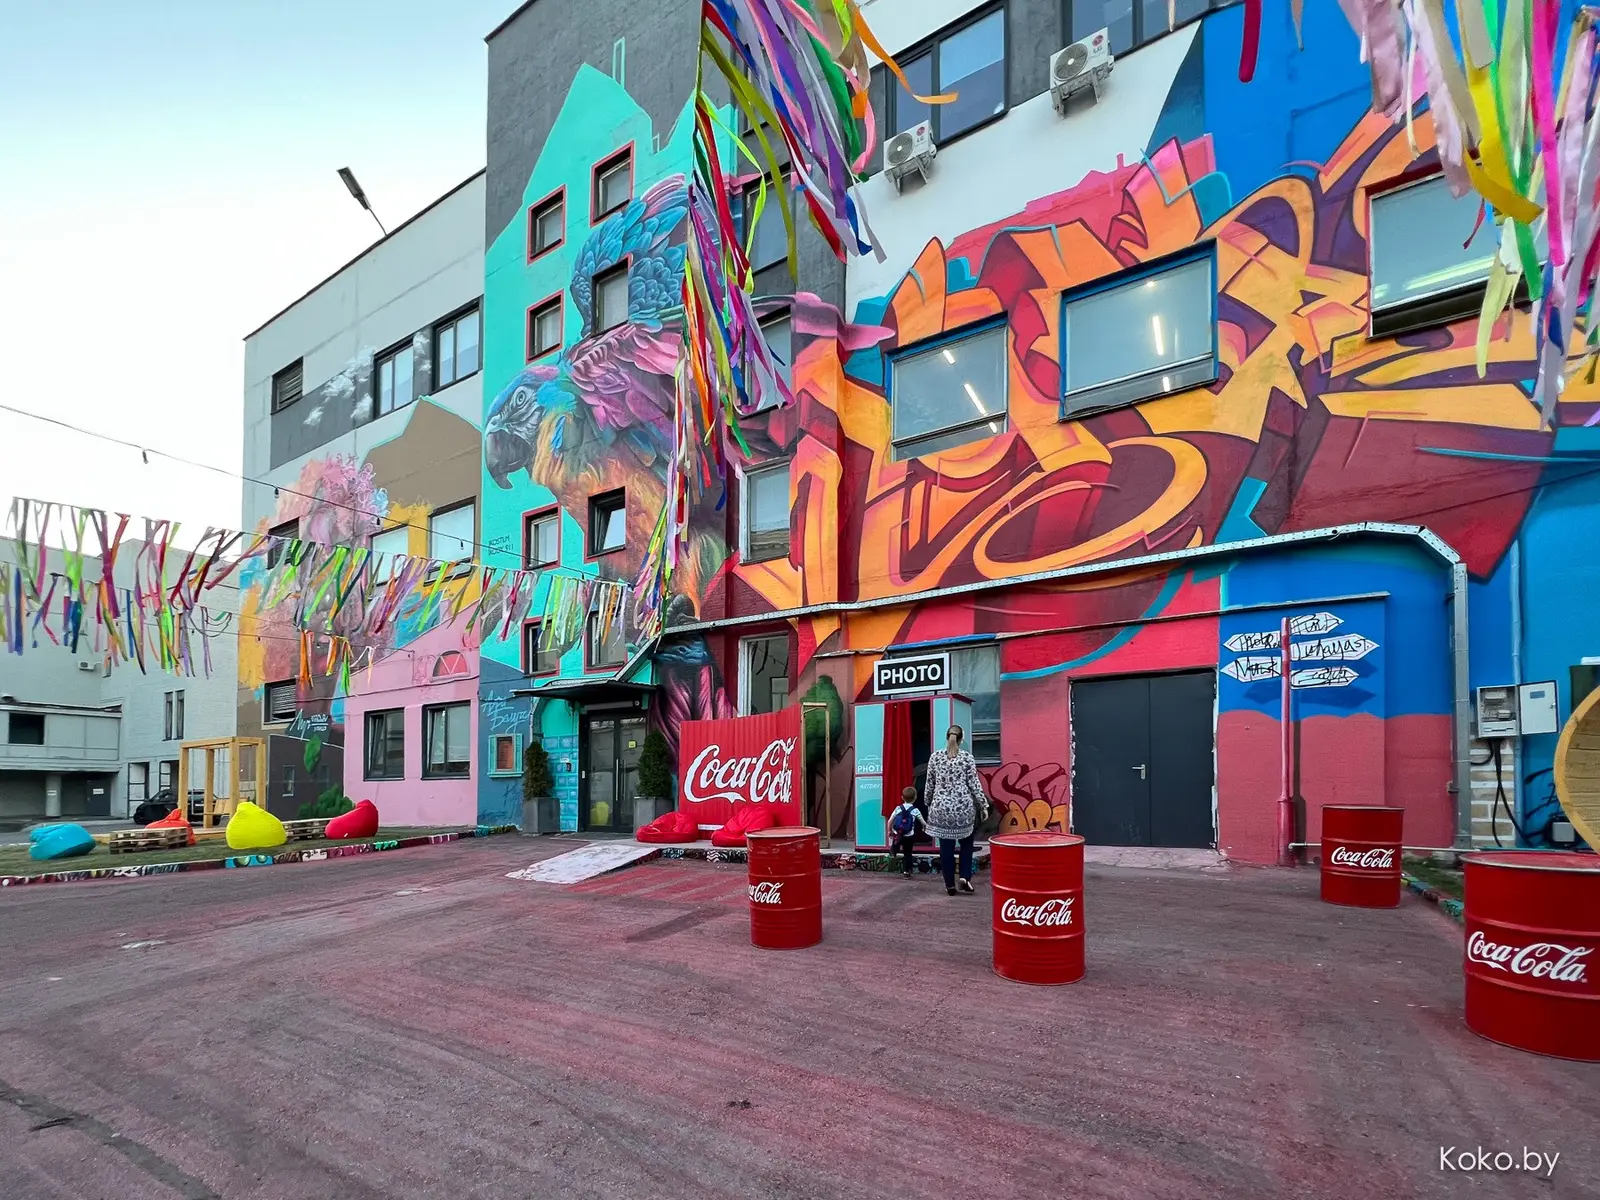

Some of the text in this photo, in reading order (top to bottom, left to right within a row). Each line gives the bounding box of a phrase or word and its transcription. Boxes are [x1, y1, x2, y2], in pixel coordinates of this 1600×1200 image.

[880, 663, 941, 686] PHOTO
[684, 736, 798, 803] Coca-Cola
[1331, 846, 1396, 868] Coca-Cola
[1001, 897, 1075, 926] Coca-Cola
[1467, 931, 1595, 983] Coca-Cola
